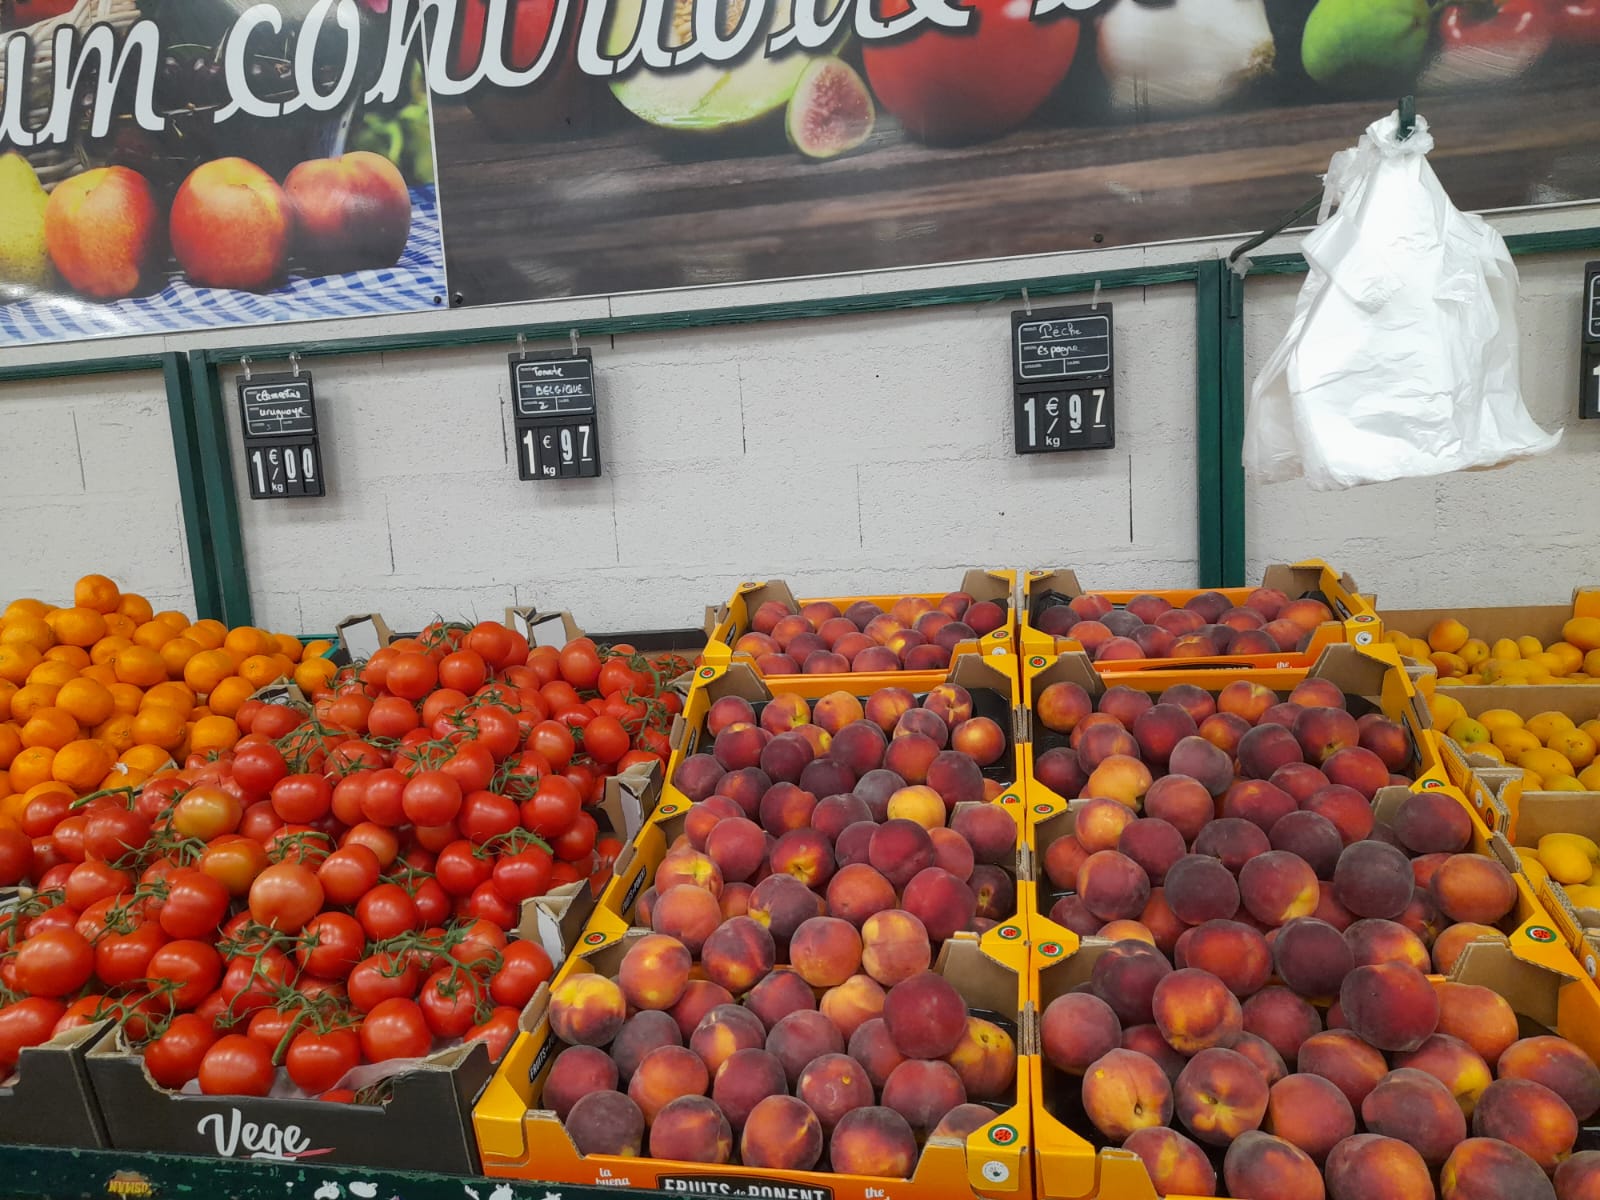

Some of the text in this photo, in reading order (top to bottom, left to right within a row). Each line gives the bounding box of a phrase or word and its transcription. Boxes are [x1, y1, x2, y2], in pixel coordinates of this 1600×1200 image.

[197, 1107, 311, 1161] Vege
[599, 1167, 612, 1178] la
[864, 1187, 885, 1198] the
